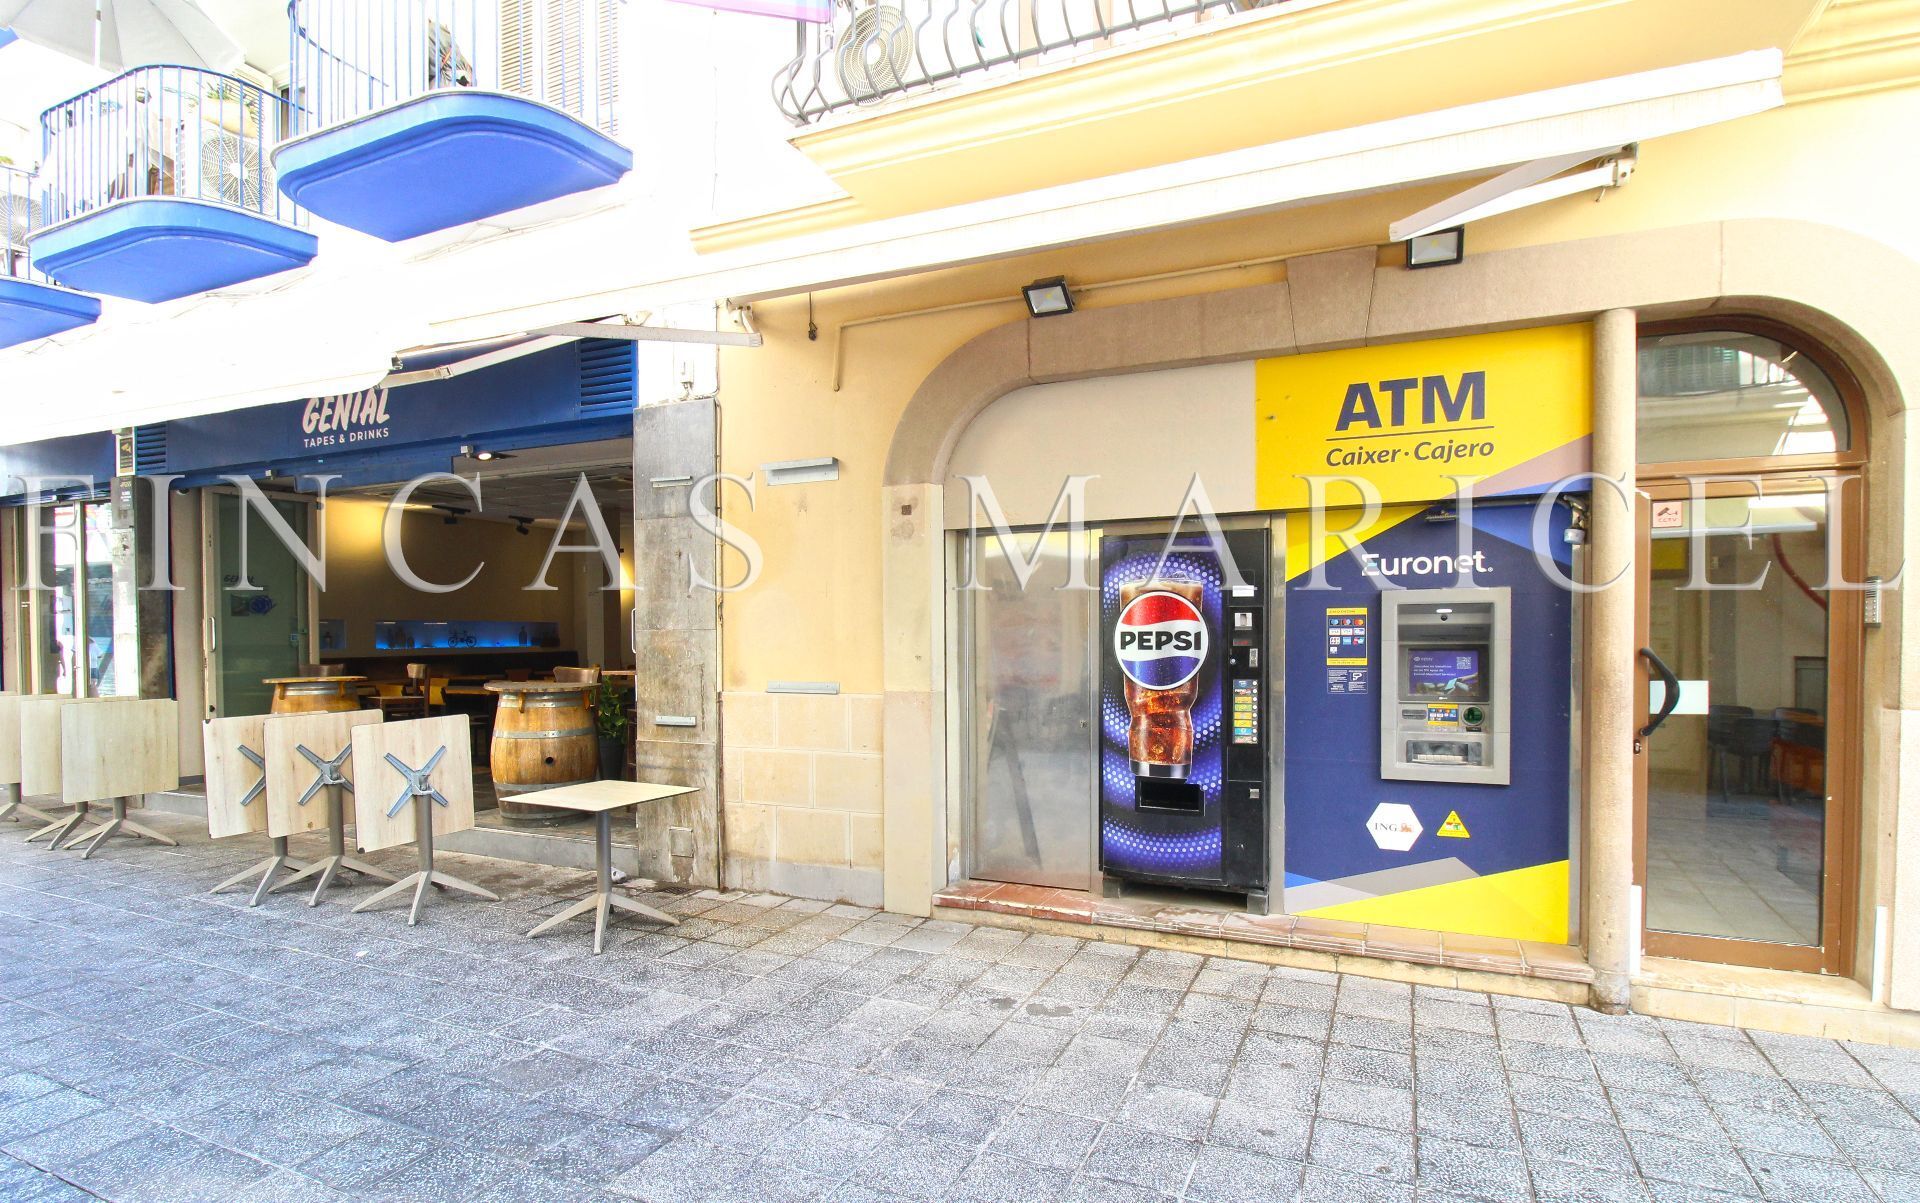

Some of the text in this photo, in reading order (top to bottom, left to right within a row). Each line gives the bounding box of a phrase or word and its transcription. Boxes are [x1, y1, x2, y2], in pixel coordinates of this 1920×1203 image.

[302, 388, 390, 433] GENIAL
[1335, 371, 1486, 431] ATM
[304, 428, 389, 448] TAPES & DRINKS
[1120, 631, 1202, 651] PEPSI
[1374, 822, 1398, 832] ING
